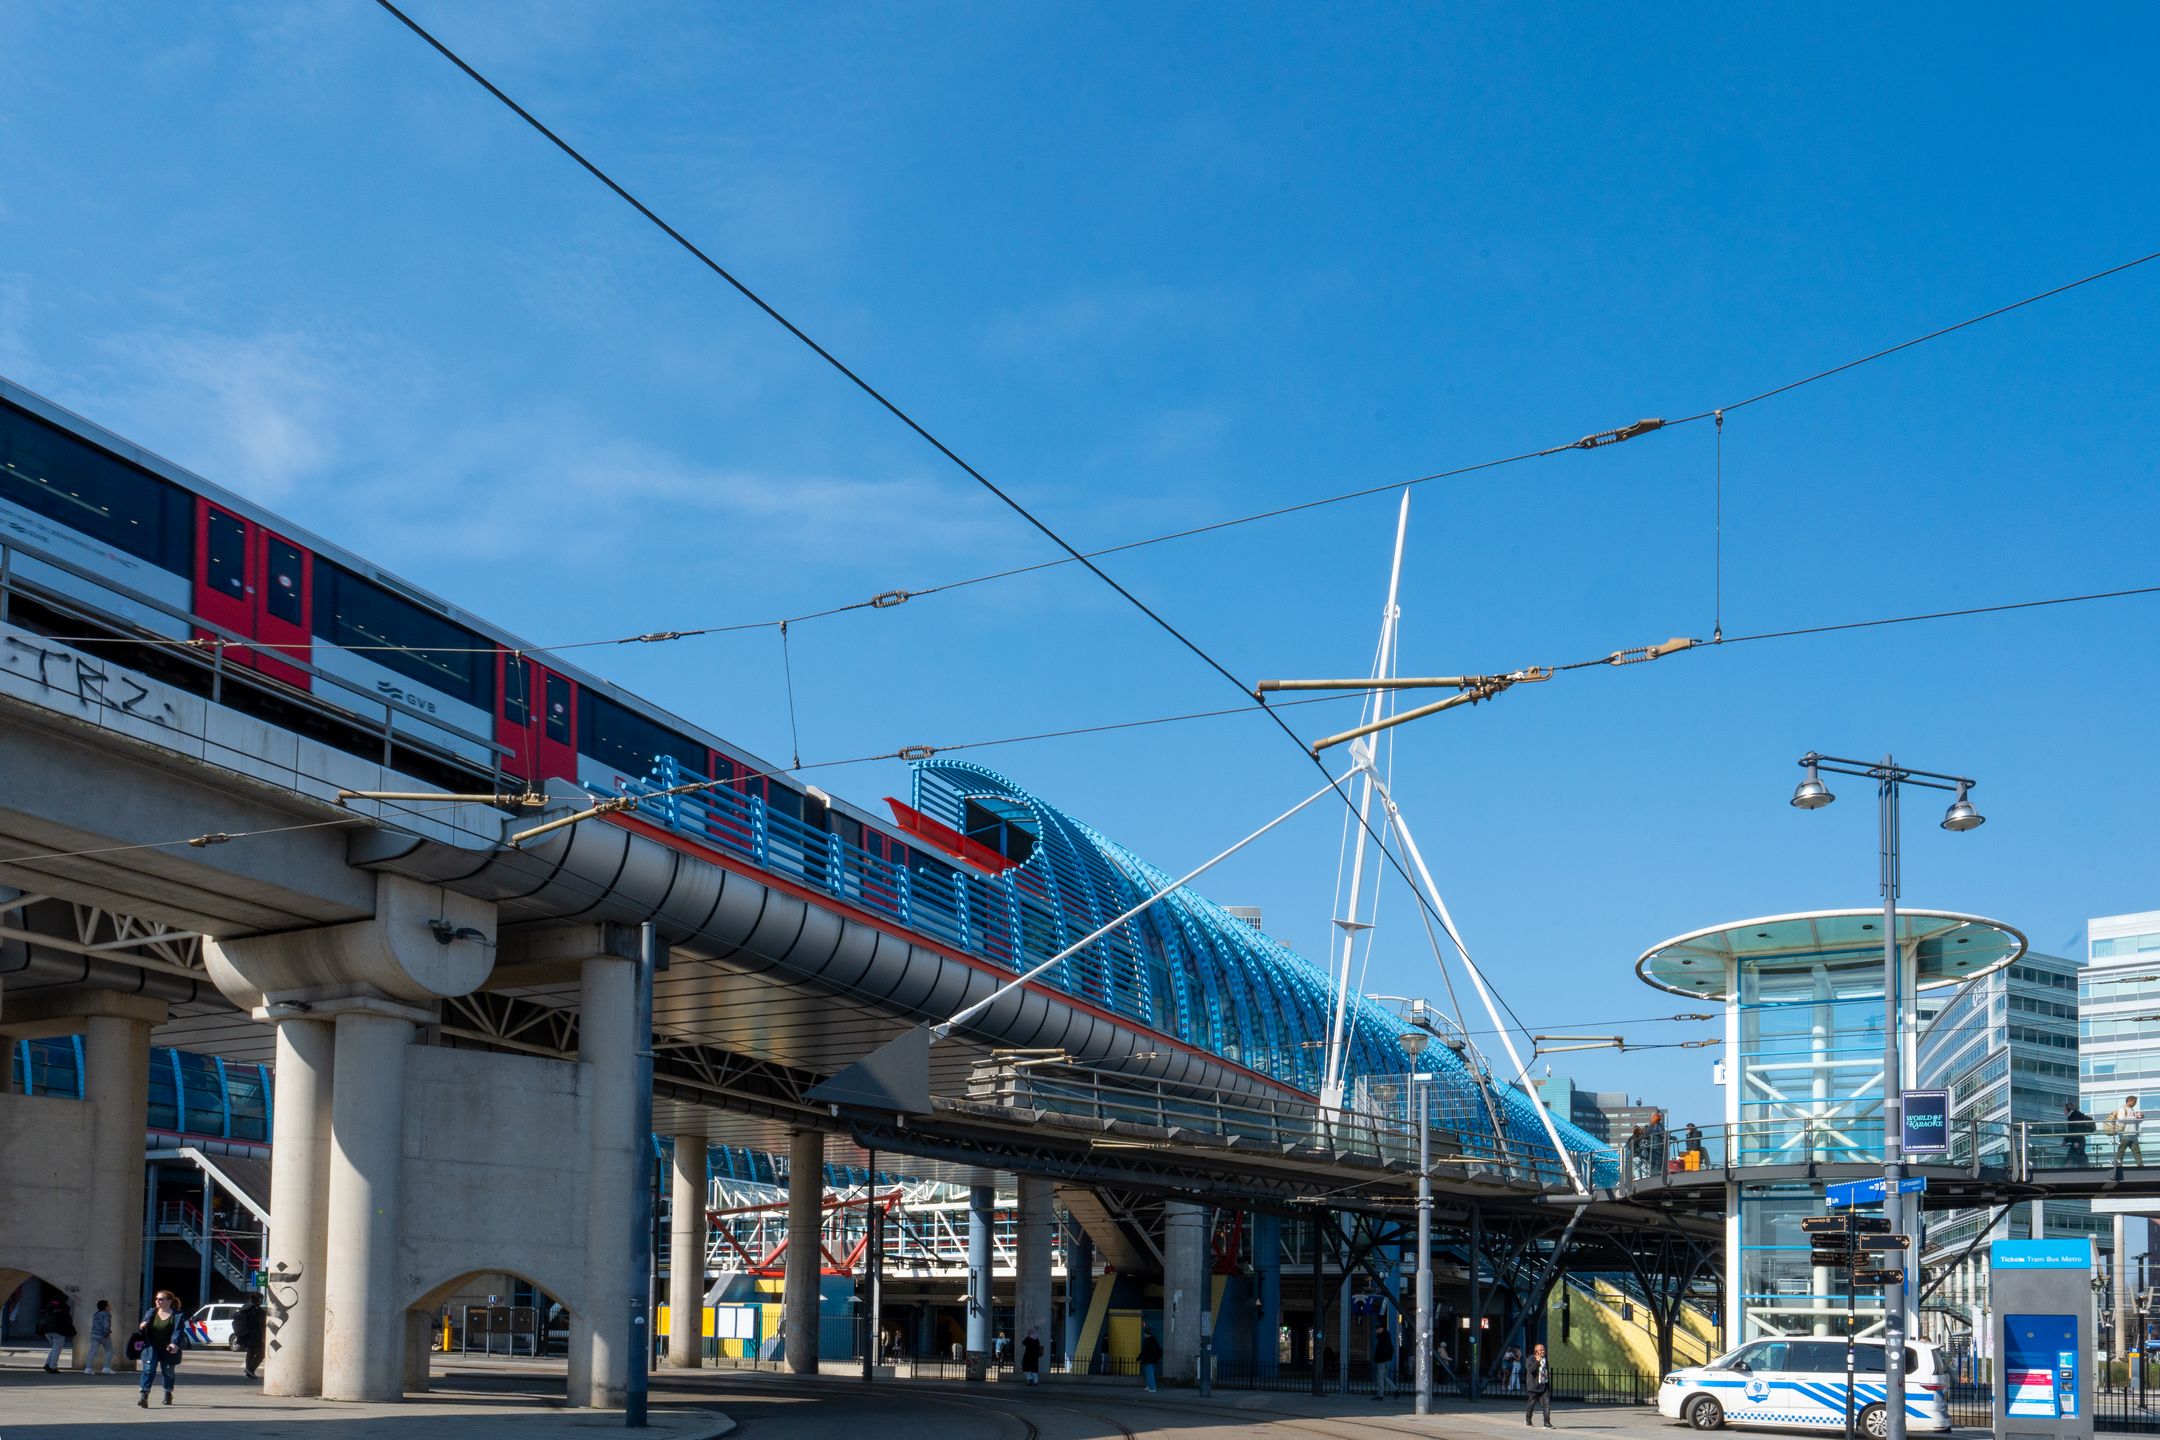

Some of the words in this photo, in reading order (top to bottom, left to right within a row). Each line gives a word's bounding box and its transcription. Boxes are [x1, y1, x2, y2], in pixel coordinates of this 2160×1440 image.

[406, 693, 437, 713] GVB
[1906, 1120, 1944, 1130] KARAOKE
[2061, 1255, 2082, 1263] Metro
